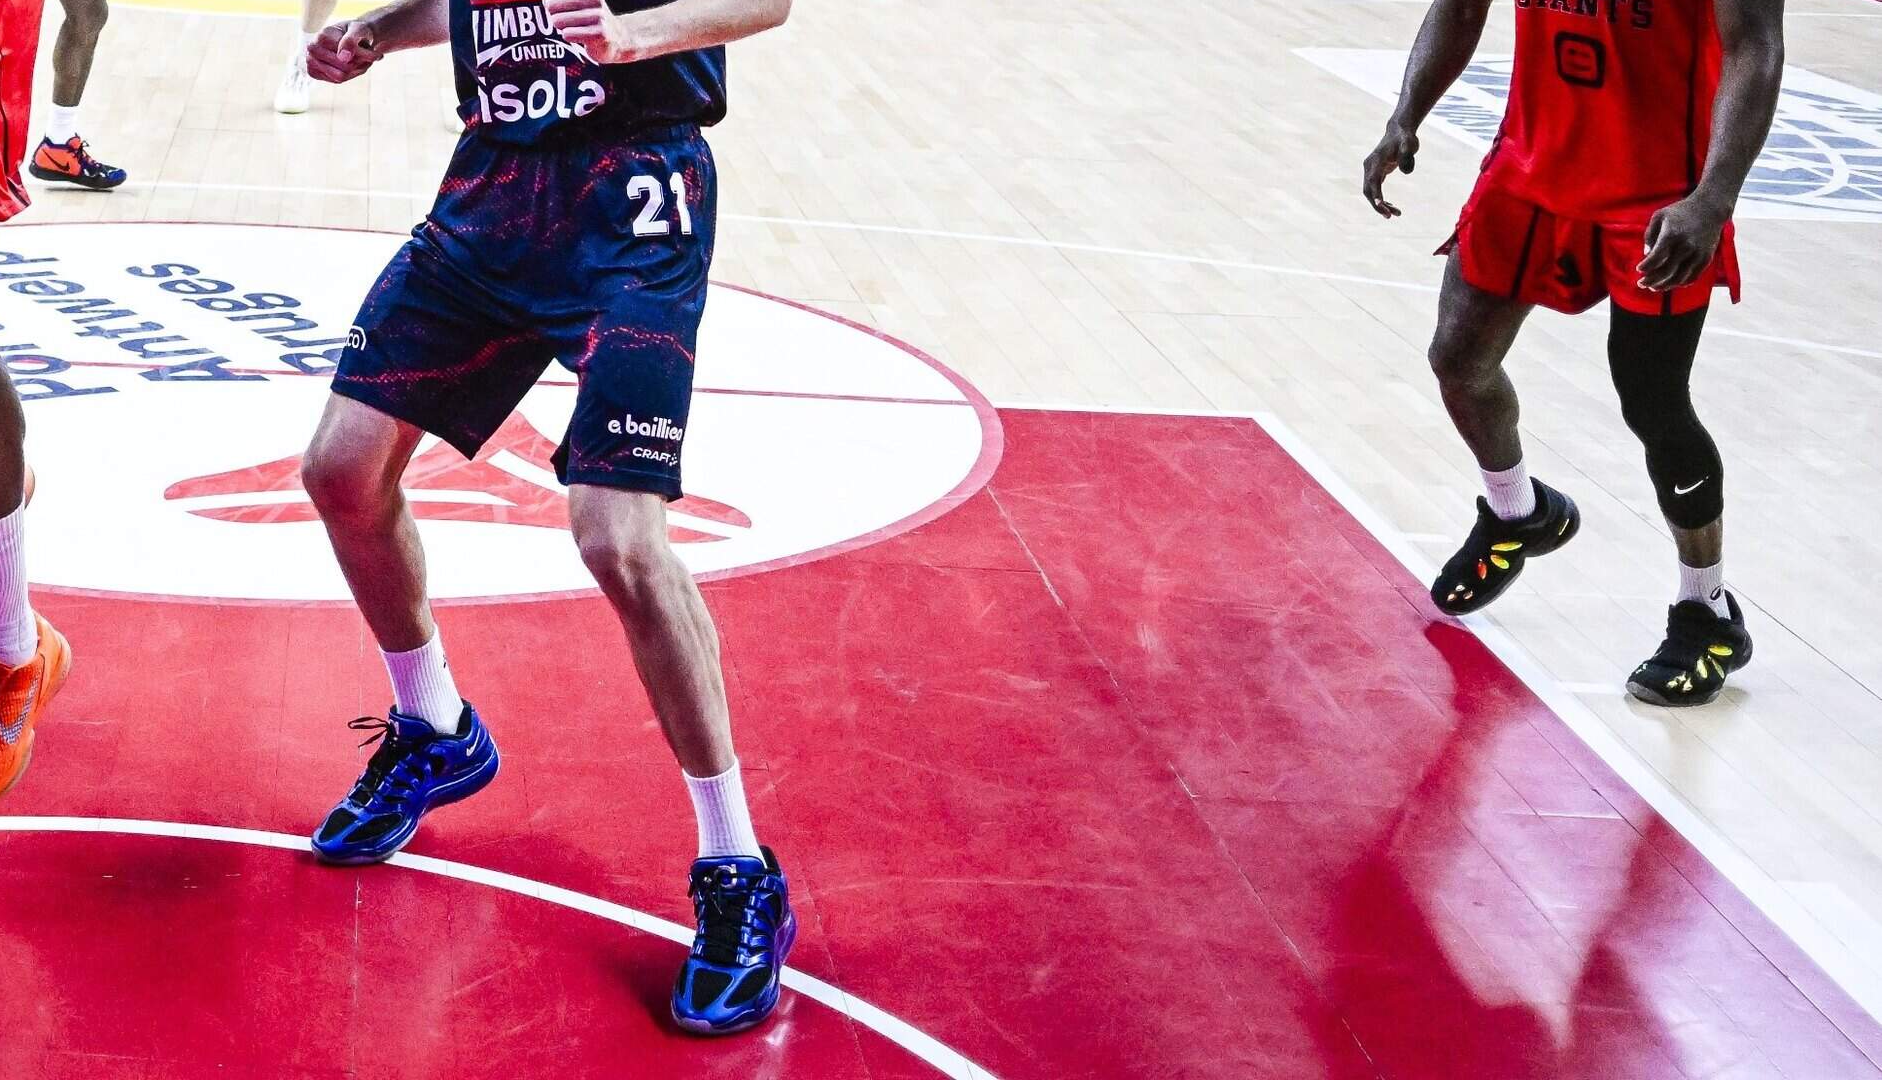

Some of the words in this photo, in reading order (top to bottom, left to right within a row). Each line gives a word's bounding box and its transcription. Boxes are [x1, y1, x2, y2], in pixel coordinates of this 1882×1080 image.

[510, 44, 566, 62] UNITED
[477, 67, 606, 124] isola
[626, 172, 692, 237] 21
[632, 447, 671, 463] CRAFT
